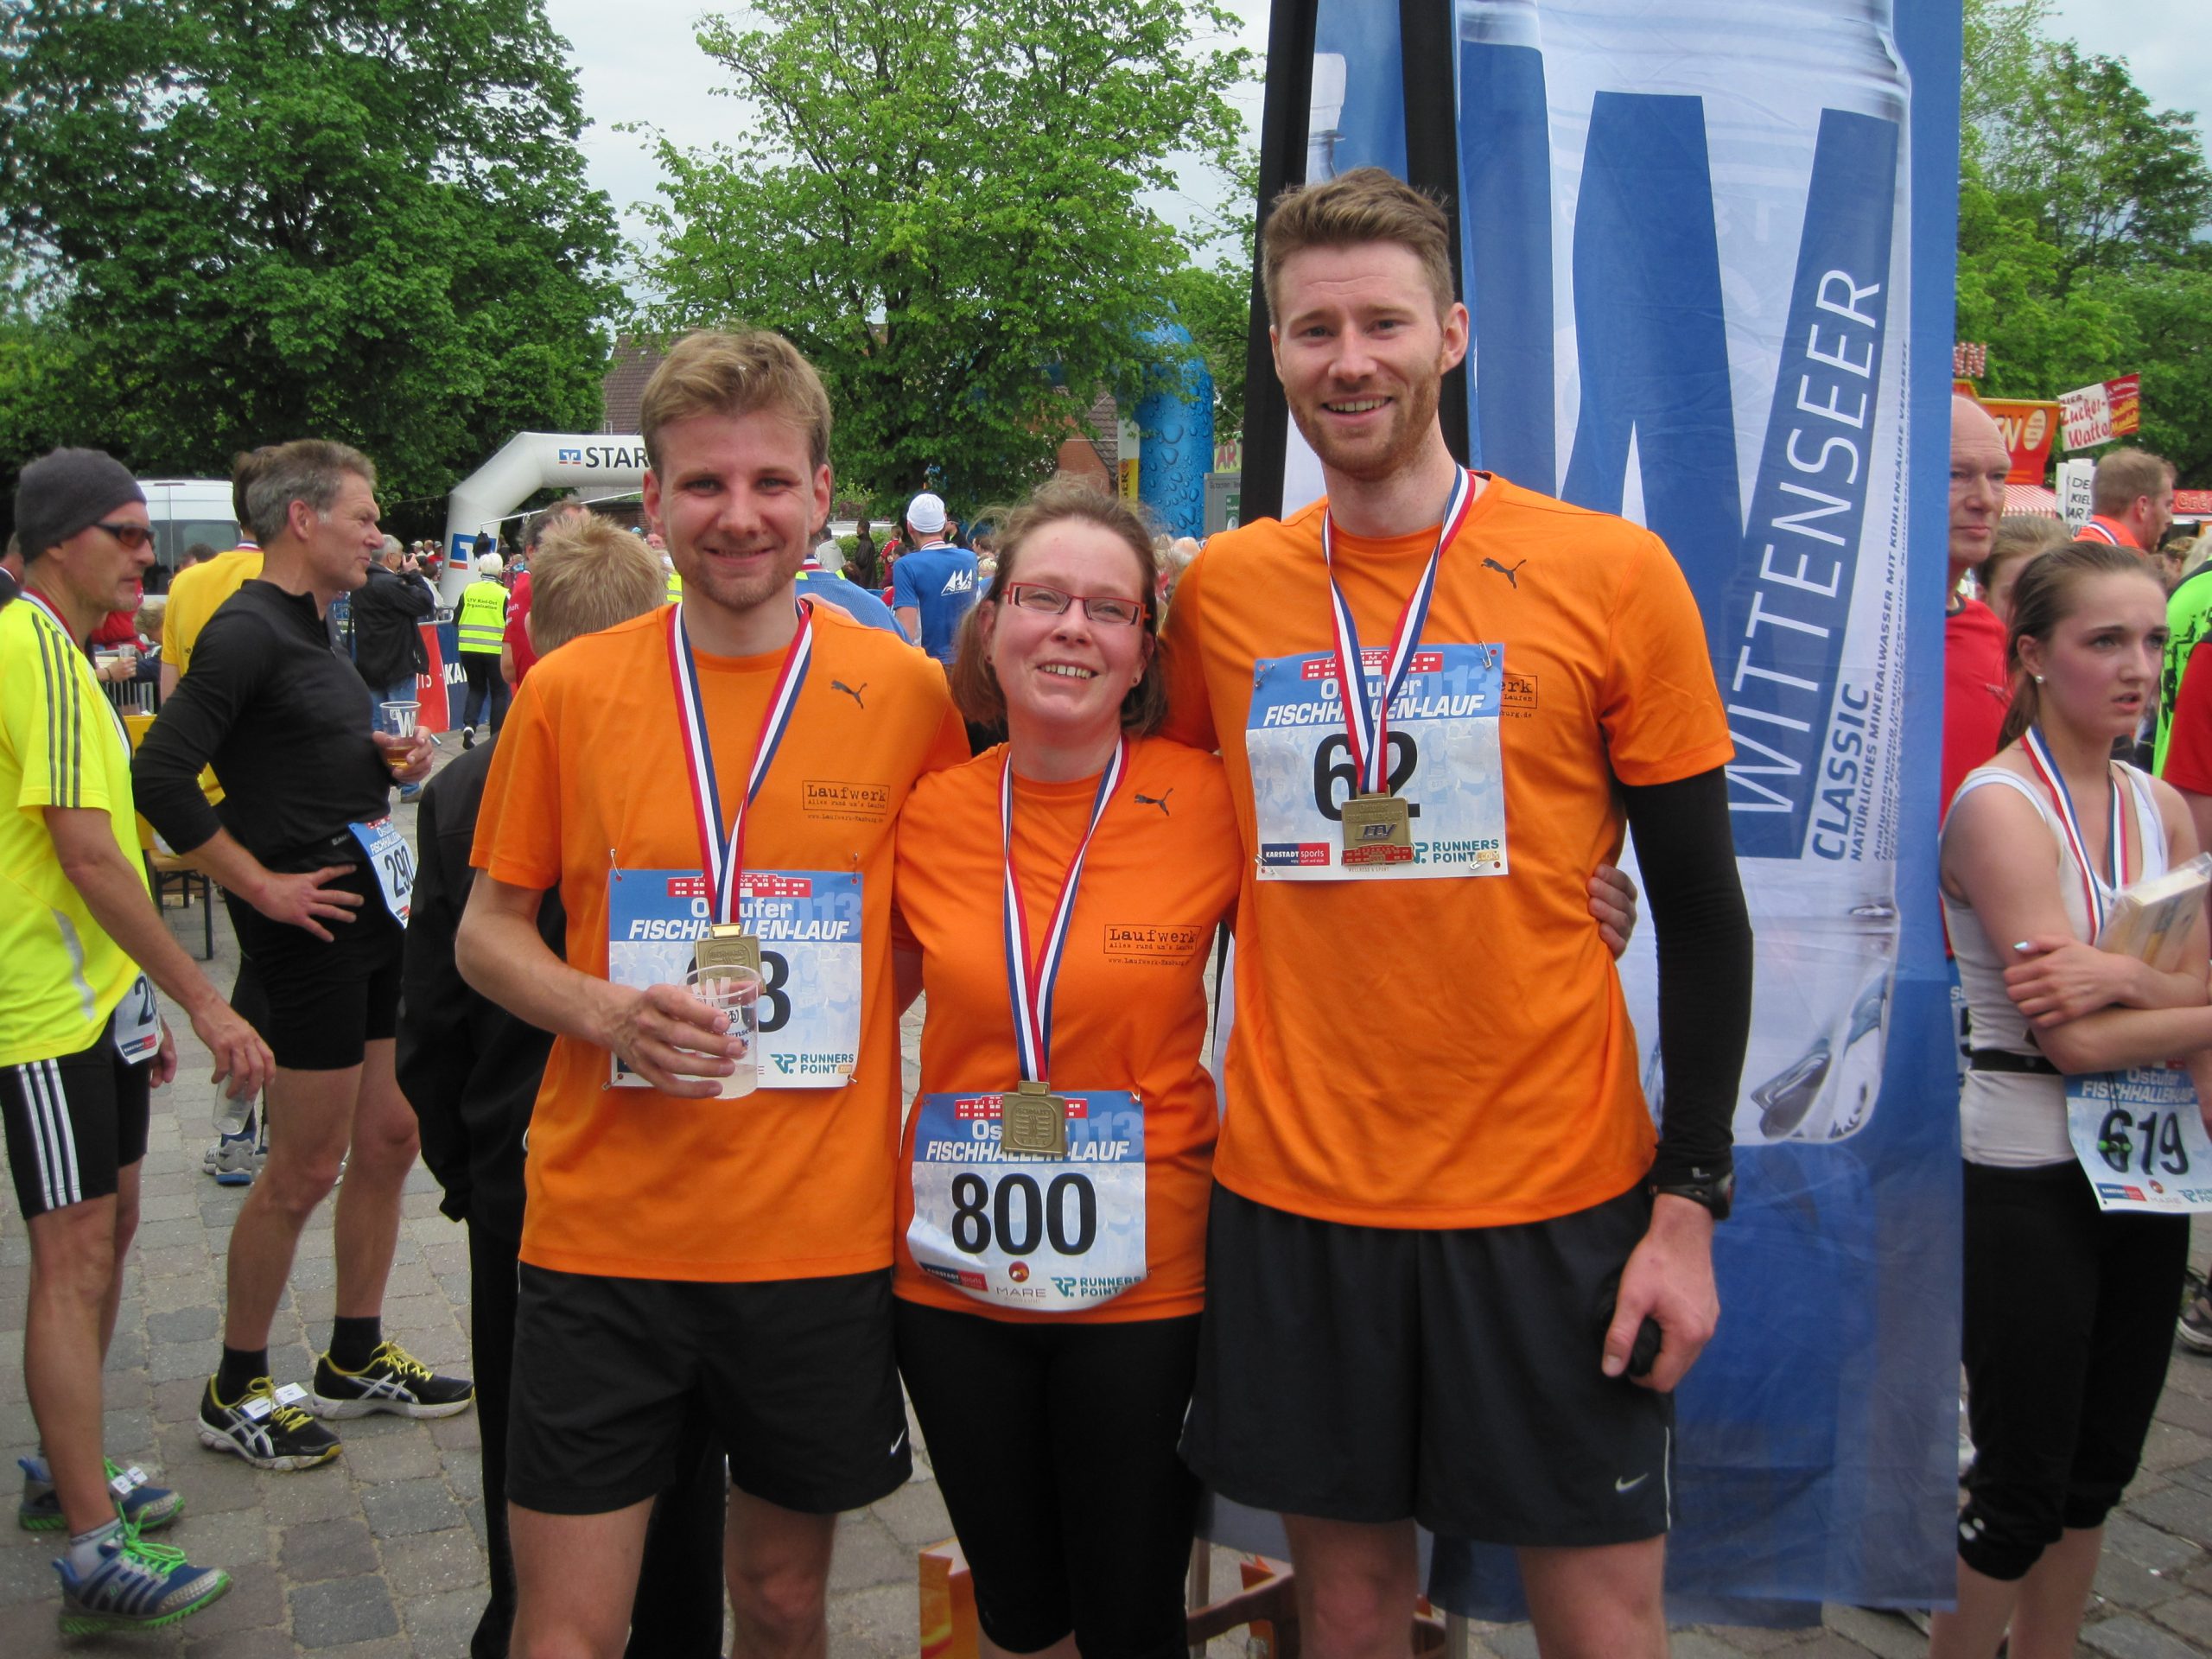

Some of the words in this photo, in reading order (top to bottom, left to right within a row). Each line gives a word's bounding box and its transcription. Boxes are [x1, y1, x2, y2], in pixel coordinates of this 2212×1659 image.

[1889, 424, 1904, 548] KOHLENSÄURE
[1726, 270, 1879, 812] WITTENSEER
[1886, 551, 1897, 585] MIT
[1868, 591, 1893, 740] MINERALWASSER
[1262, 695, 1484, 727] FISCHHLEN-LAUF
[1313, 731, 1421, 822] 62
[1812, 683, 1870, 861] CLASSIC
[807, 785, 886, 802] Laufwerk
[1851, 745, 1878, 862] NATÜRLICHES
[1300, 849, 1325, 859] sports
[1433, 838, 1499, 853] RUNNERS
[1433, 851, 1476, 863] POINT
[691, 897, 793, 918] Oufer
[629, 919, 850, 940] FISCHHLEN-LAUF
[1109, 928, 1196, 944] Laufwerk
[800, 1053, 855, 1064] RUNNERS
[800, 1064, 837, 1074] POINT
[2097, 1109, 2189, 1175] 619
[951, 1172, 1097, 1256] 800
[1079, 1276, 1141, 1287] RUNNERS
[1080, 1285, 1120, 1298] POINT
[996, 1287, 1046, 1298] MARE
